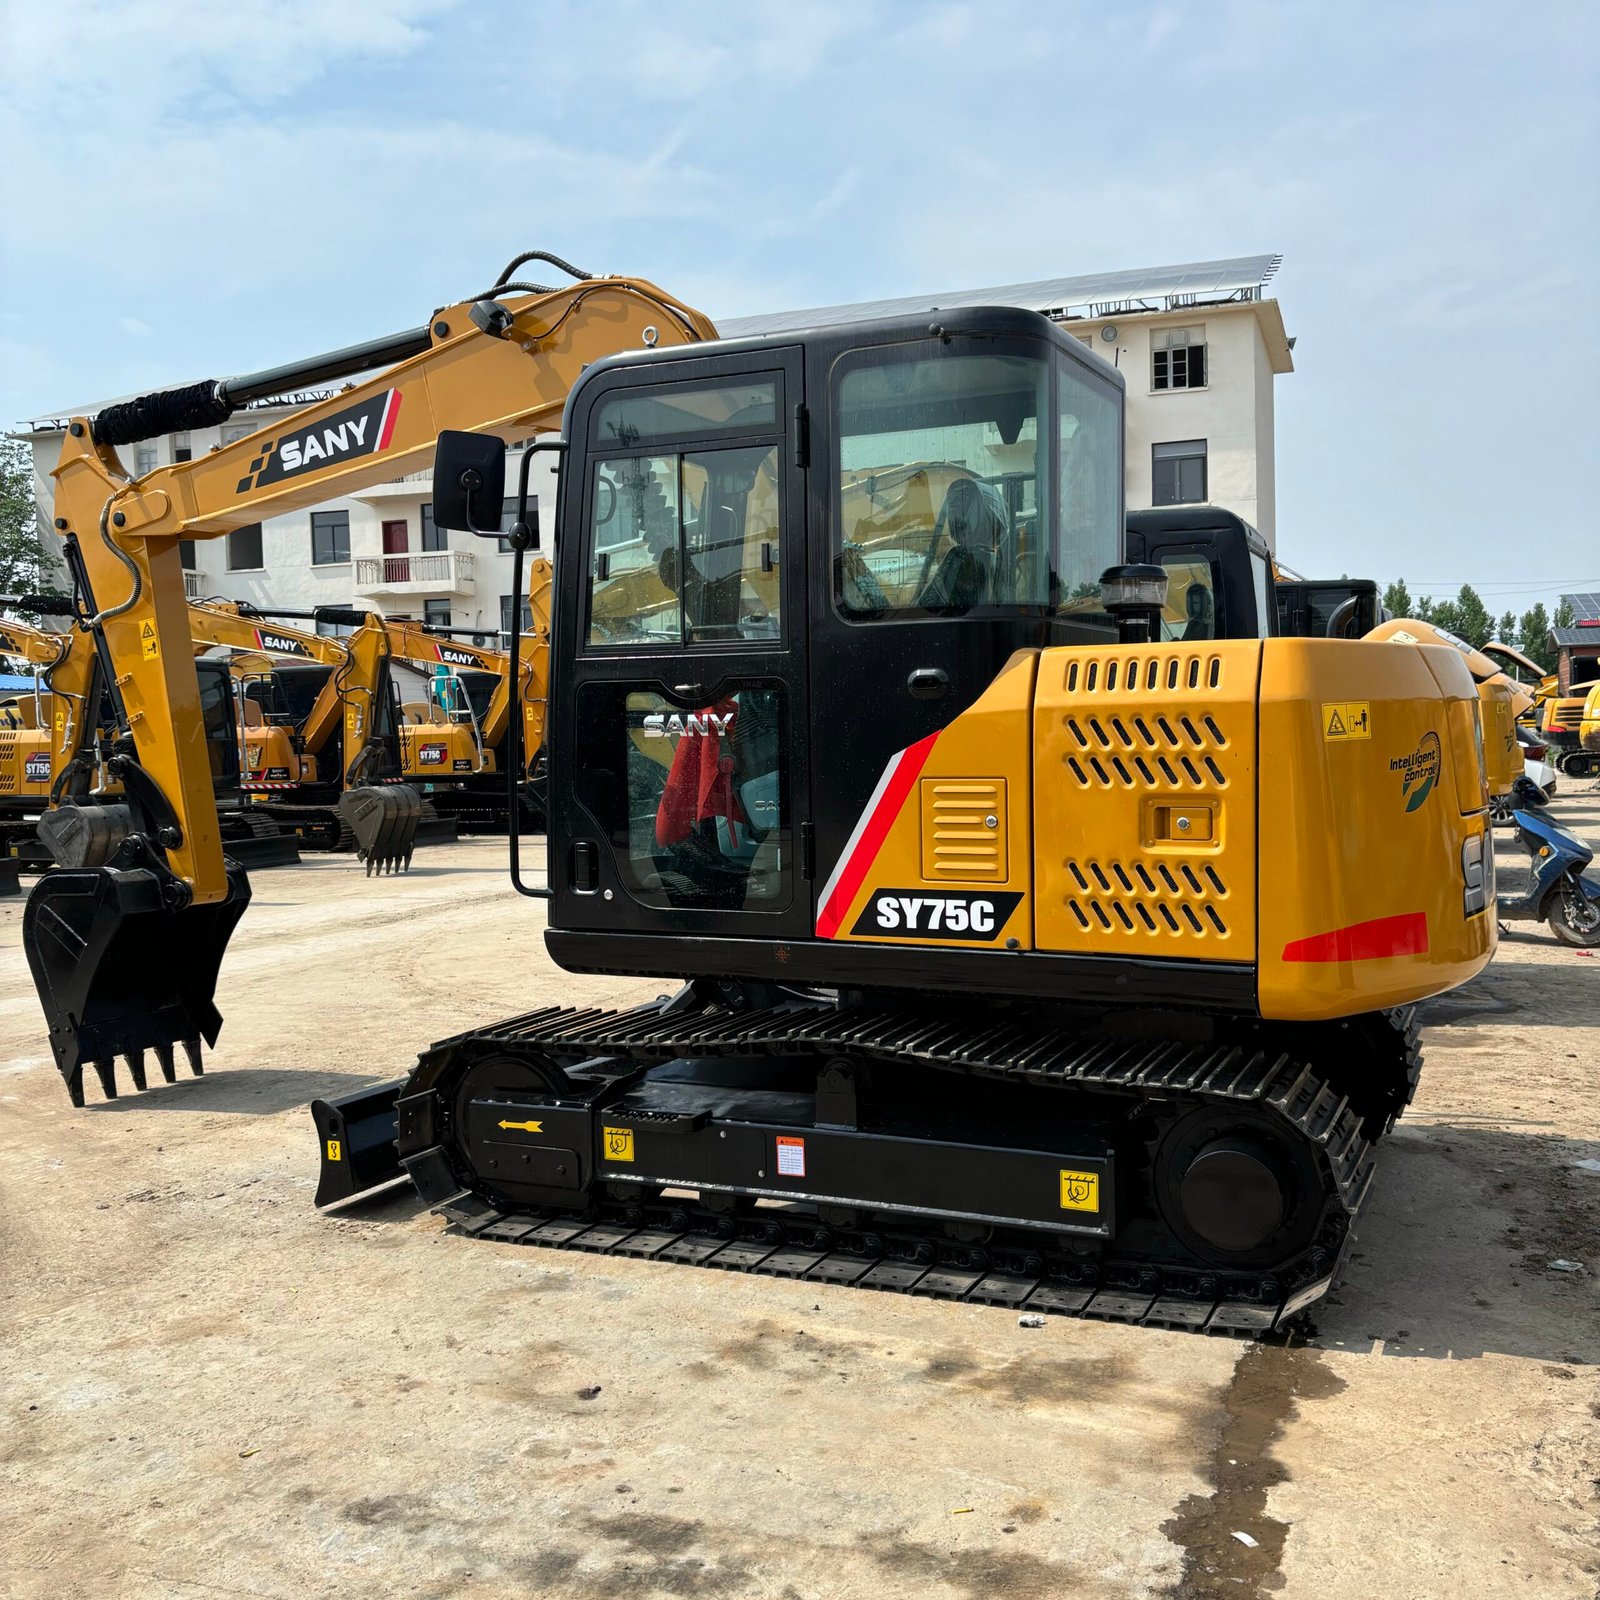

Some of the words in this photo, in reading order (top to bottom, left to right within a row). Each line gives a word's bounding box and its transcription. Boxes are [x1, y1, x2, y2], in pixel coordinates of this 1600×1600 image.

[280, 415, 368, 471] SANY
[264, 636, 297, 651] SANY
[443, 651, 474, 665] SANY
[643, 713, 734, 737] SANY
[420, 750, 440, 759] SY75C
[1390, 749, 1435, 771] Intelligent
[26, 763, 50, 774] SY75C
[1404, 765, 1436, 782] control
[876, 897, 995, 932] SY75C
